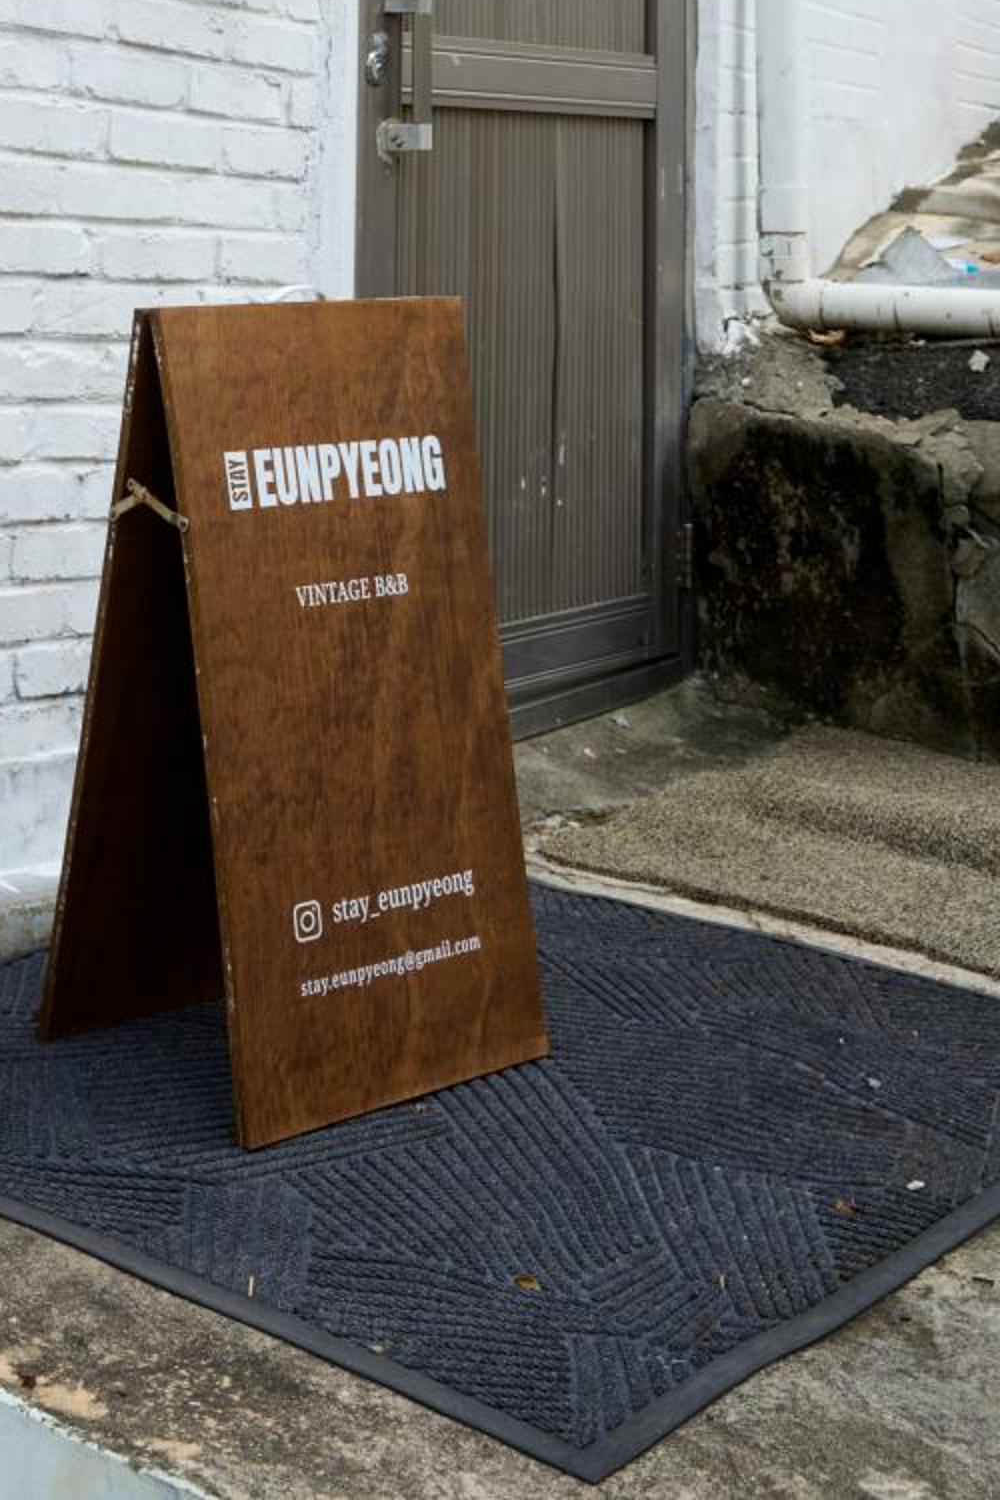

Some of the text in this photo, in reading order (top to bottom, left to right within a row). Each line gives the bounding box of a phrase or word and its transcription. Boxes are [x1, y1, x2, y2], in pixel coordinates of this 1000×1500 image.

[228, 434, 447, 508] STAY EUNPYEONG
[296, 573, 409, 608] VINTAGE B&B
[332, 868, 475, 924] stay_eunpyeong
[300, 935, 481, 997] stay.eunpyeong@gmail.com
